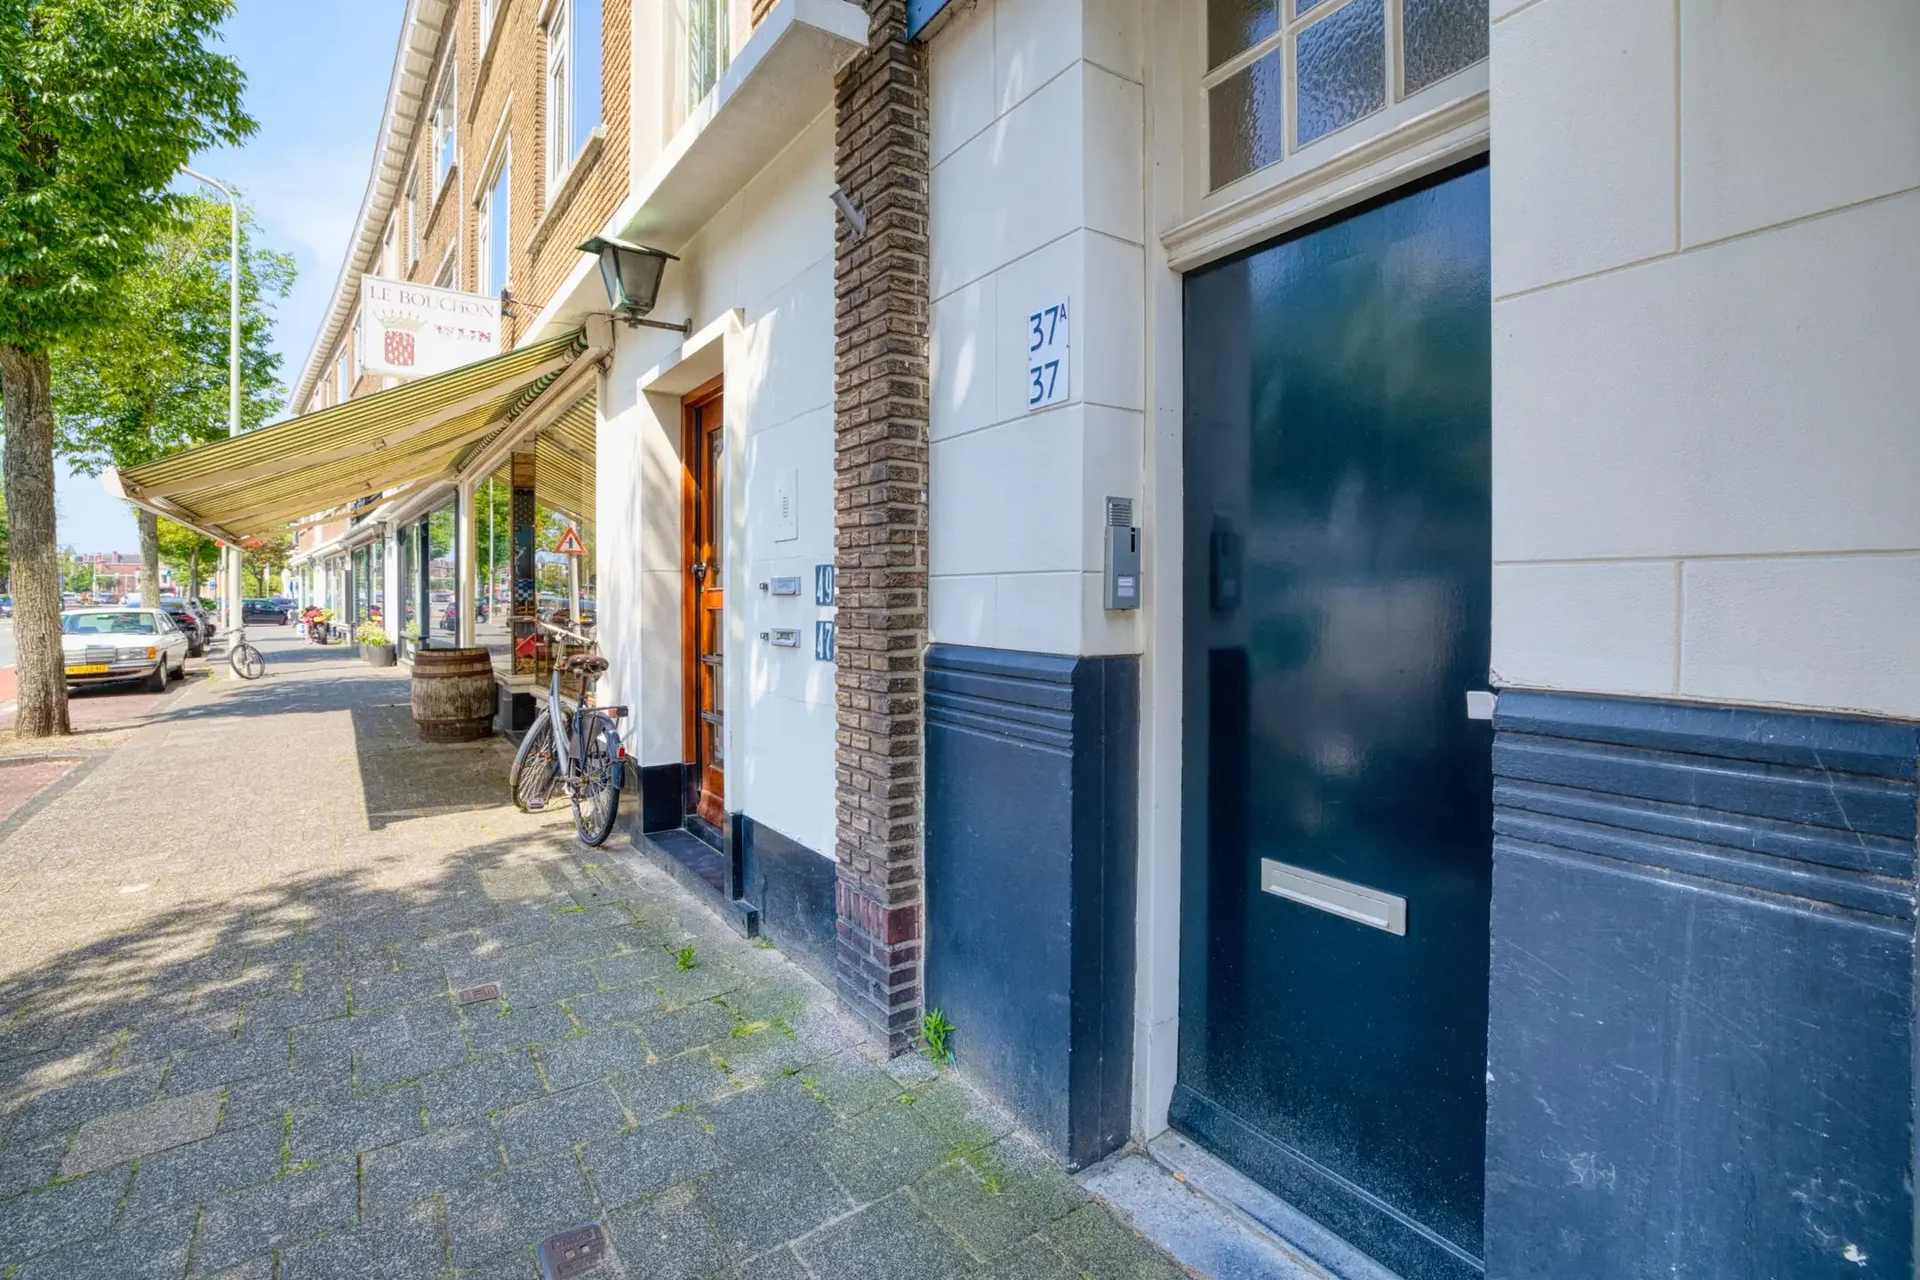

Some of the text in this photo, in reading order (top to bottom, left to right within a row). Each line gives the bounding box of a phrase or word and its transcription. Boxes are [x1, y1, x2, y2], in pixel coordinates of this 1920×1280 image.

[371, 286, 493, 317] LE BOUCHON
[1030, 359, 1060, 404] 37
[817, 566, 833, 603] 49
[817, 622, 833, 659] 47
